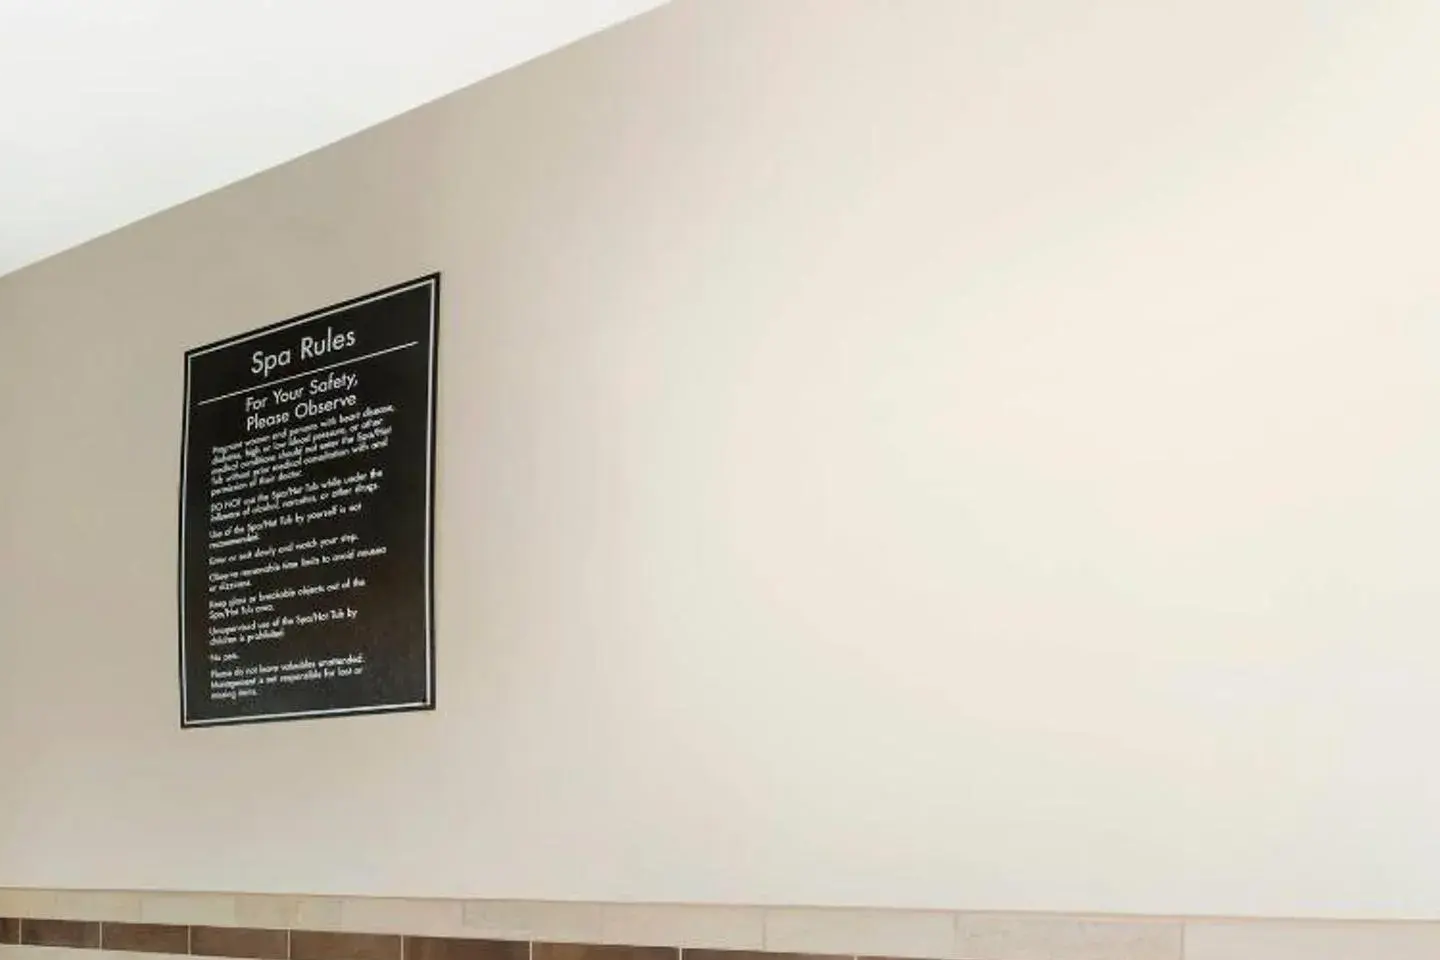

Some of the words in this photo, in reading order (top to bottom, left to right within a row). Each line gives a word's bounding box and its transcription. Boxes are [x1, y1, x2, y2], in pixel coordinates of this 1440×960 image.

[251, 350, 291, 377] Spa
[300, 327, 356, 360] Rules
[245, 392, 268, 413] For
[273, 386, 304, 407] Your
[310, 372, 359, 394] Safety,
[246, 412, 289, 431] Please
[295, 393, 357, 418] Observe
